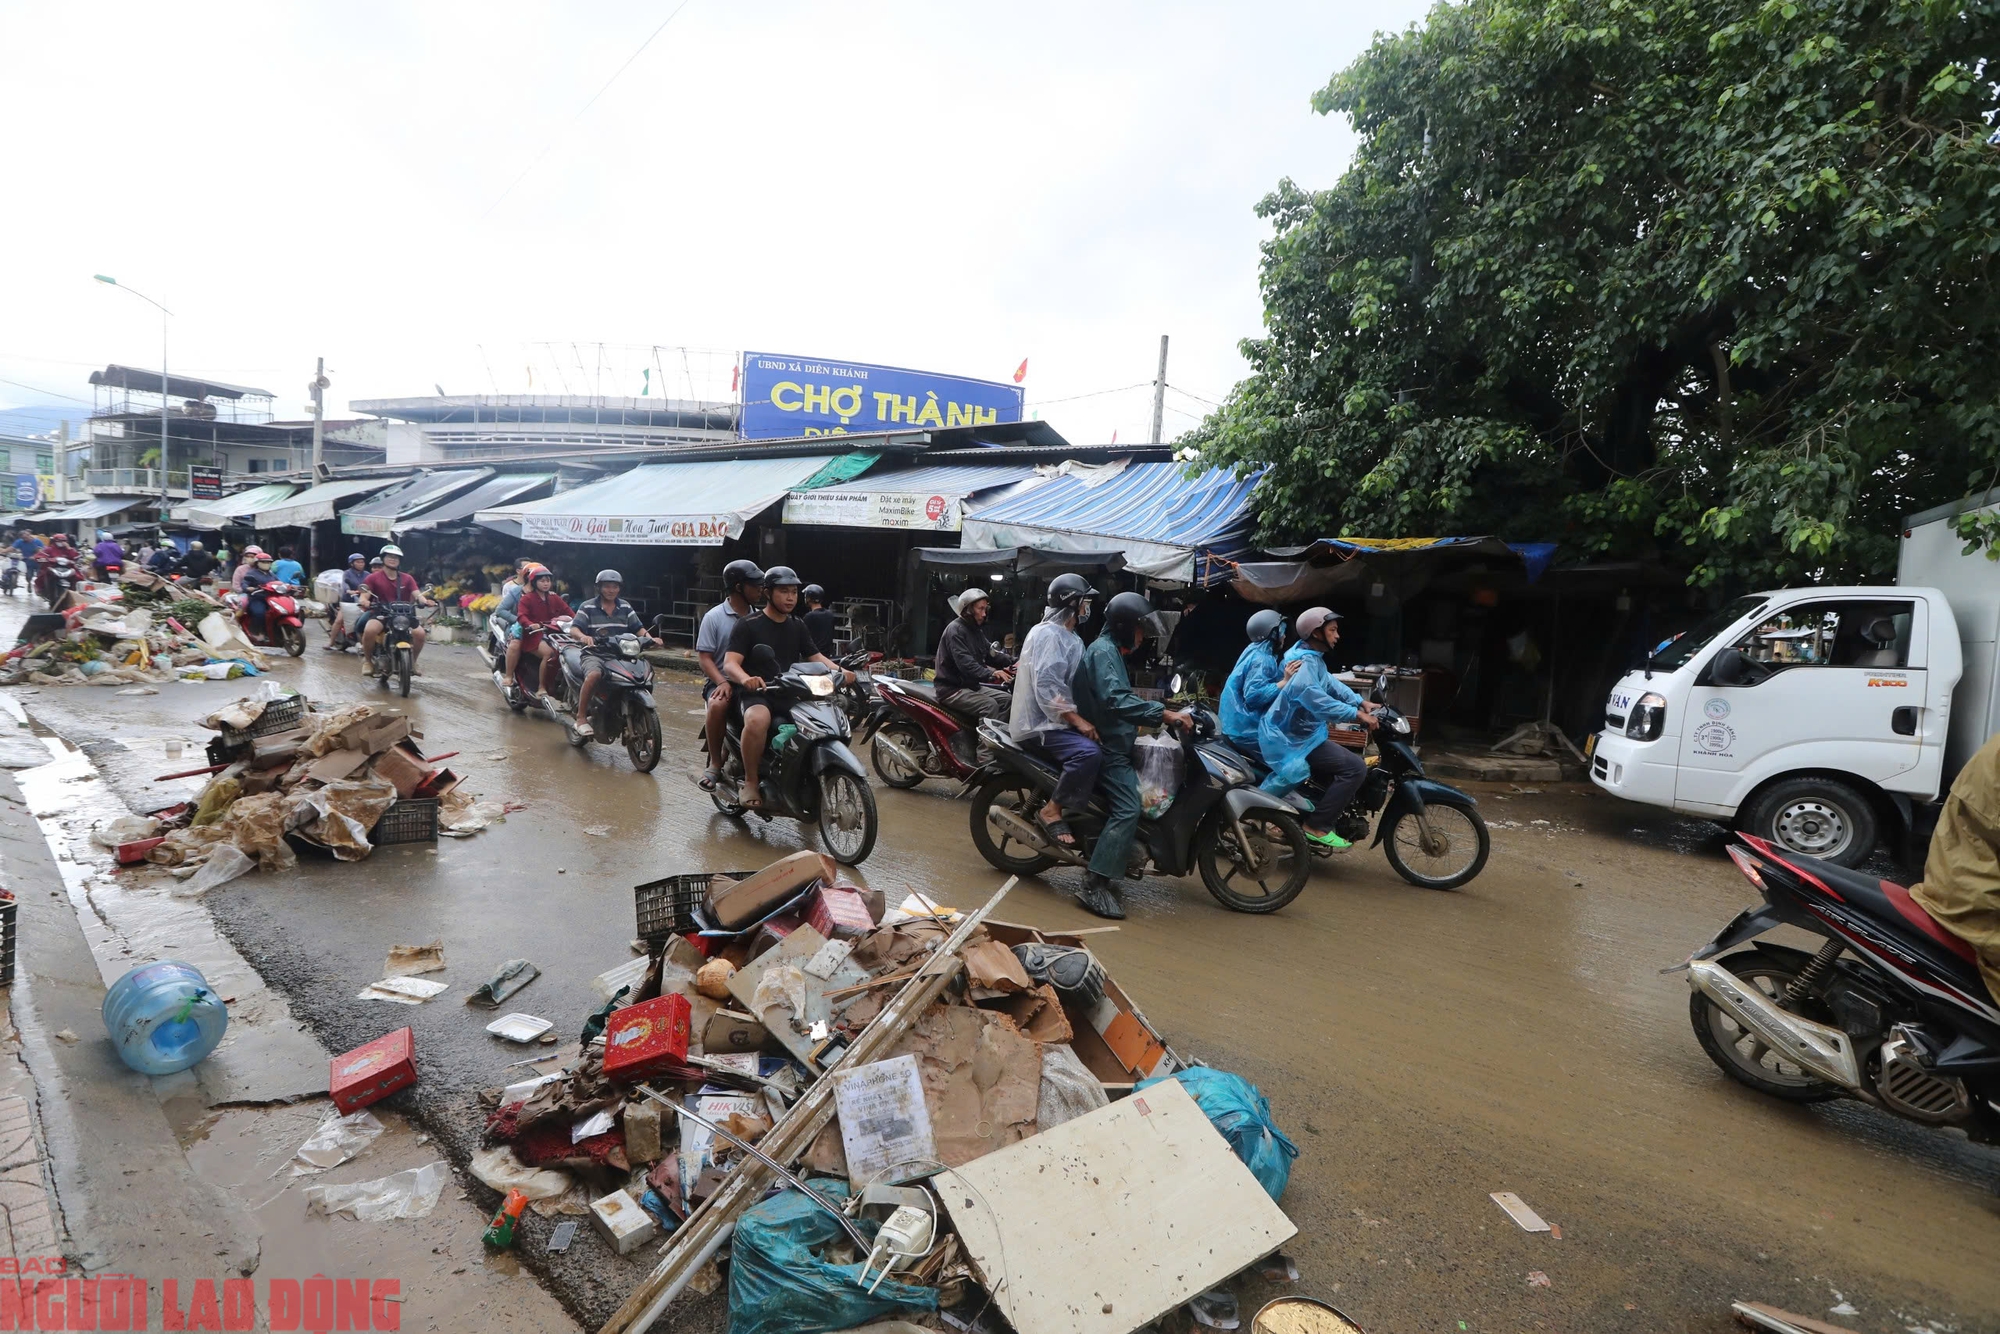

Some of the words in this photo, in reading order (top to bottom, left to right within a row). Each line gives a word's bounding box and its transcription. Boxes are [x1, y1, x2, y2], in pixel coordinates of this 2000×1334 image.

[758, 360, 786, 370] UBND
[788, 361, 802, 372] XÃ
[804, 363, 830, 375] DIÊN
[832, 367, 868, 379] KHÁNH
[770, 381, 863, 424] CHỢ
[872, 390, 997, 427] THÀNH
[879, 506, 915, 515] MaximBike
[624, 519, 644, 533] Hoa
[671, 521, 696, 537] GIA
[882, 517, 909, 526] maxim
[1846, 921, 1917, 965] BLADE
[844, 1072, 898, 1091] VINAPHONE
